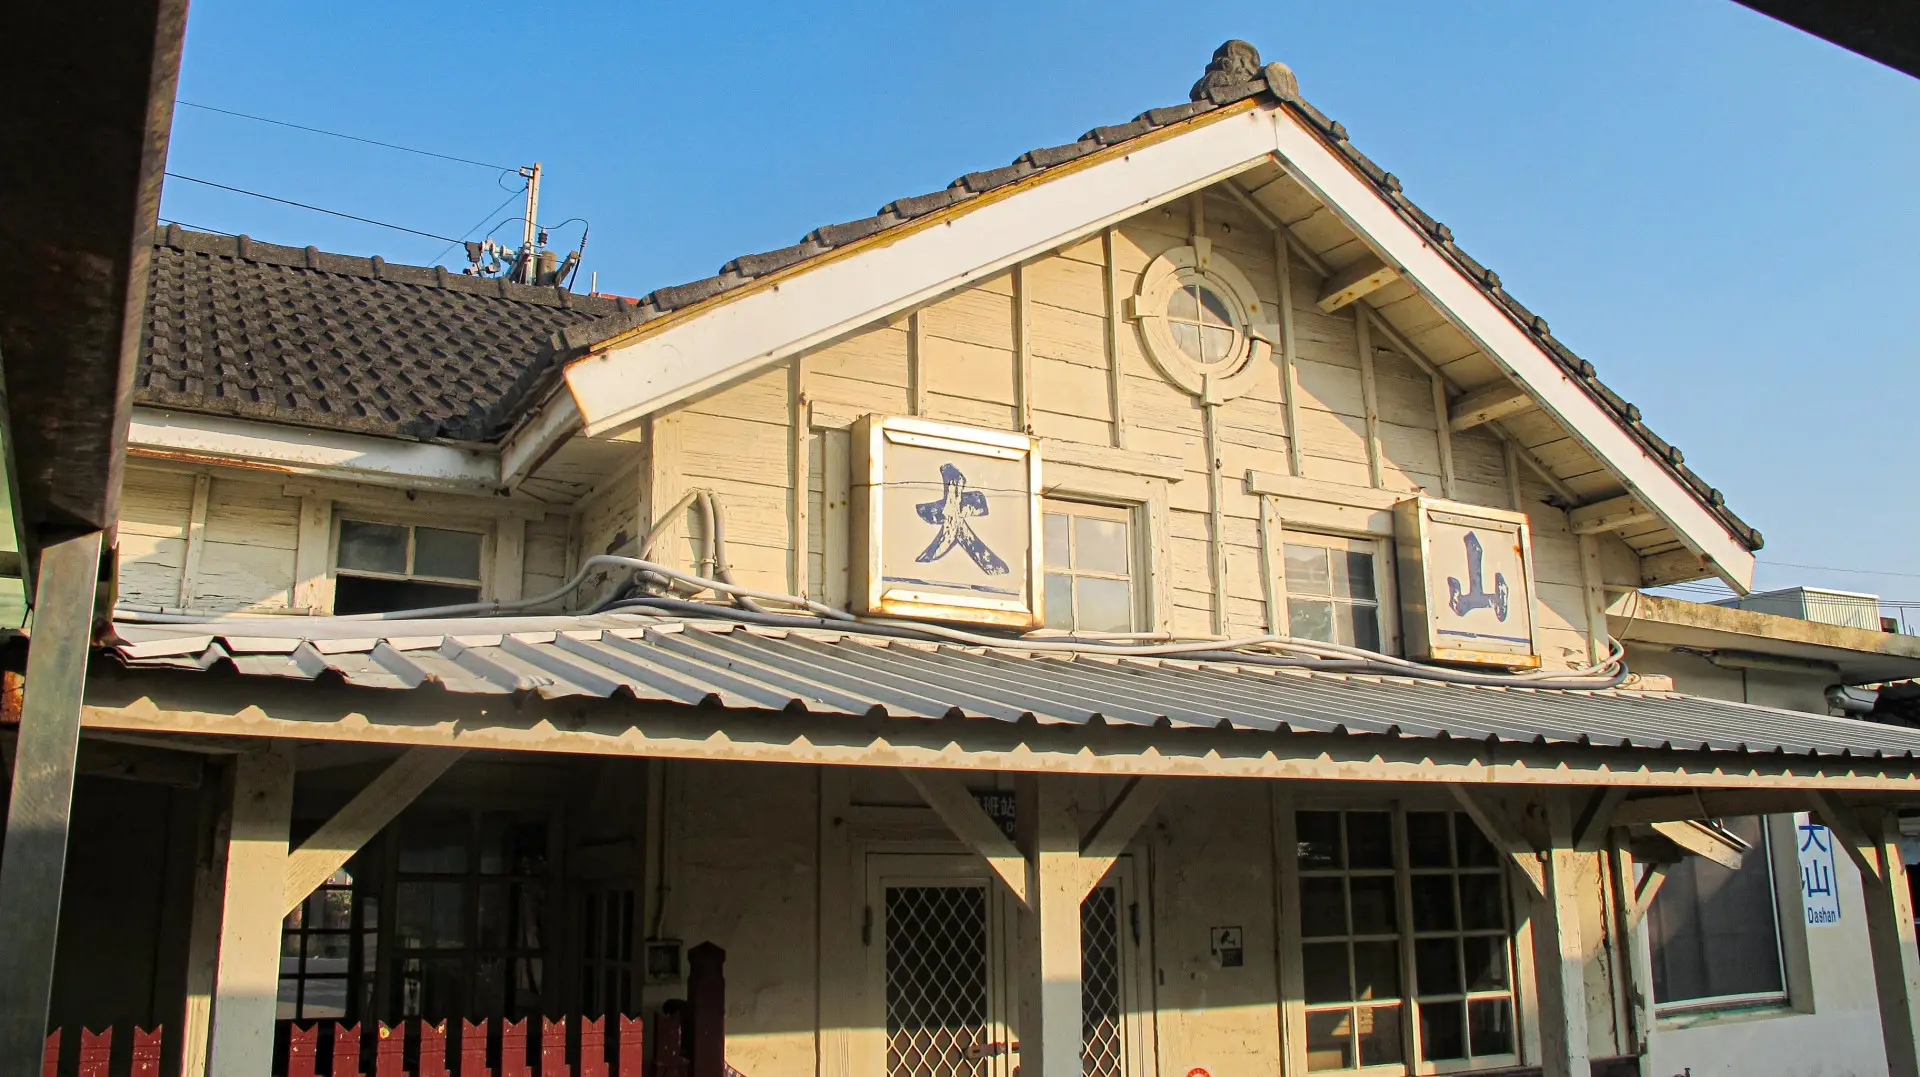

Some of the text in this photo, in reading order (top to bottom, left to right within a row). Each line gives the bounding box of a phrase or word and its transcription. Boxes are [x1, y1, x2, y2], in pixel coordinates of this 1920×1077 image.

[915, 463, 1009, 576] 大
[1447, 531, 1508, 622] 山
[978, 796, 1016, 817] 班站
[1798, 824, 1831, 897] 大山
[1807, 907, 1837, 923] Dashan
